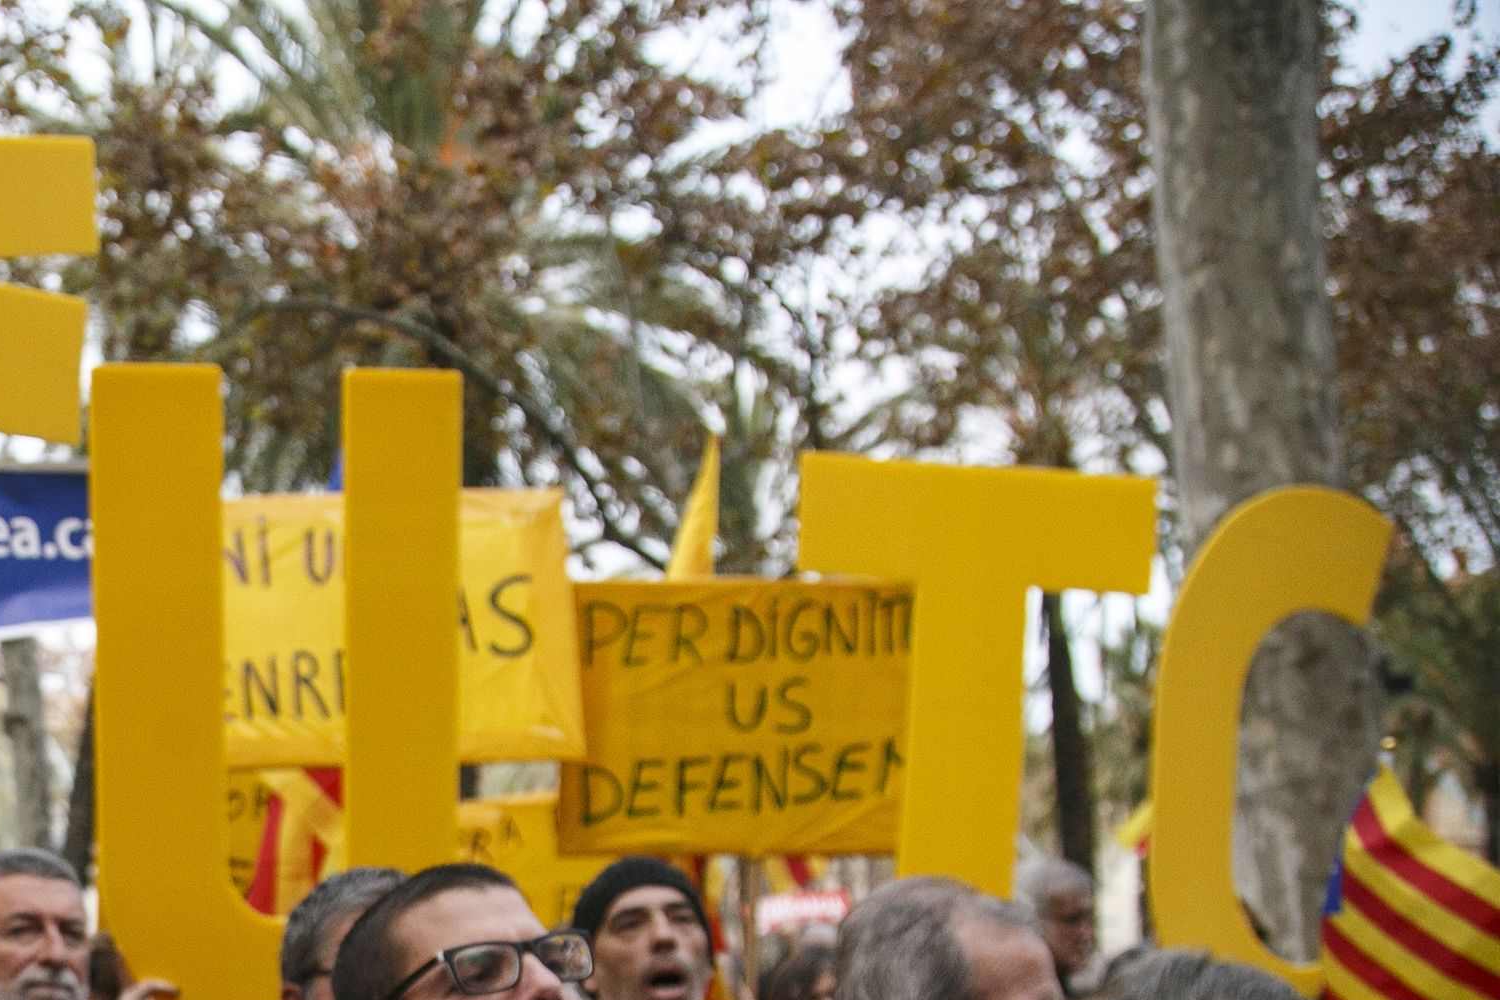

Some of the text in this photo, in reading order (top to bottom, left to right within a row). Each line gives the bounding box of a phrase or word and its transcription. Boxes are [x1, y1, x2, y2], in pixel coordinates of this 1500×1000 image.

[584, 588, 915, 669] PER DIGNIT
[726, 676, 814, 735] US
